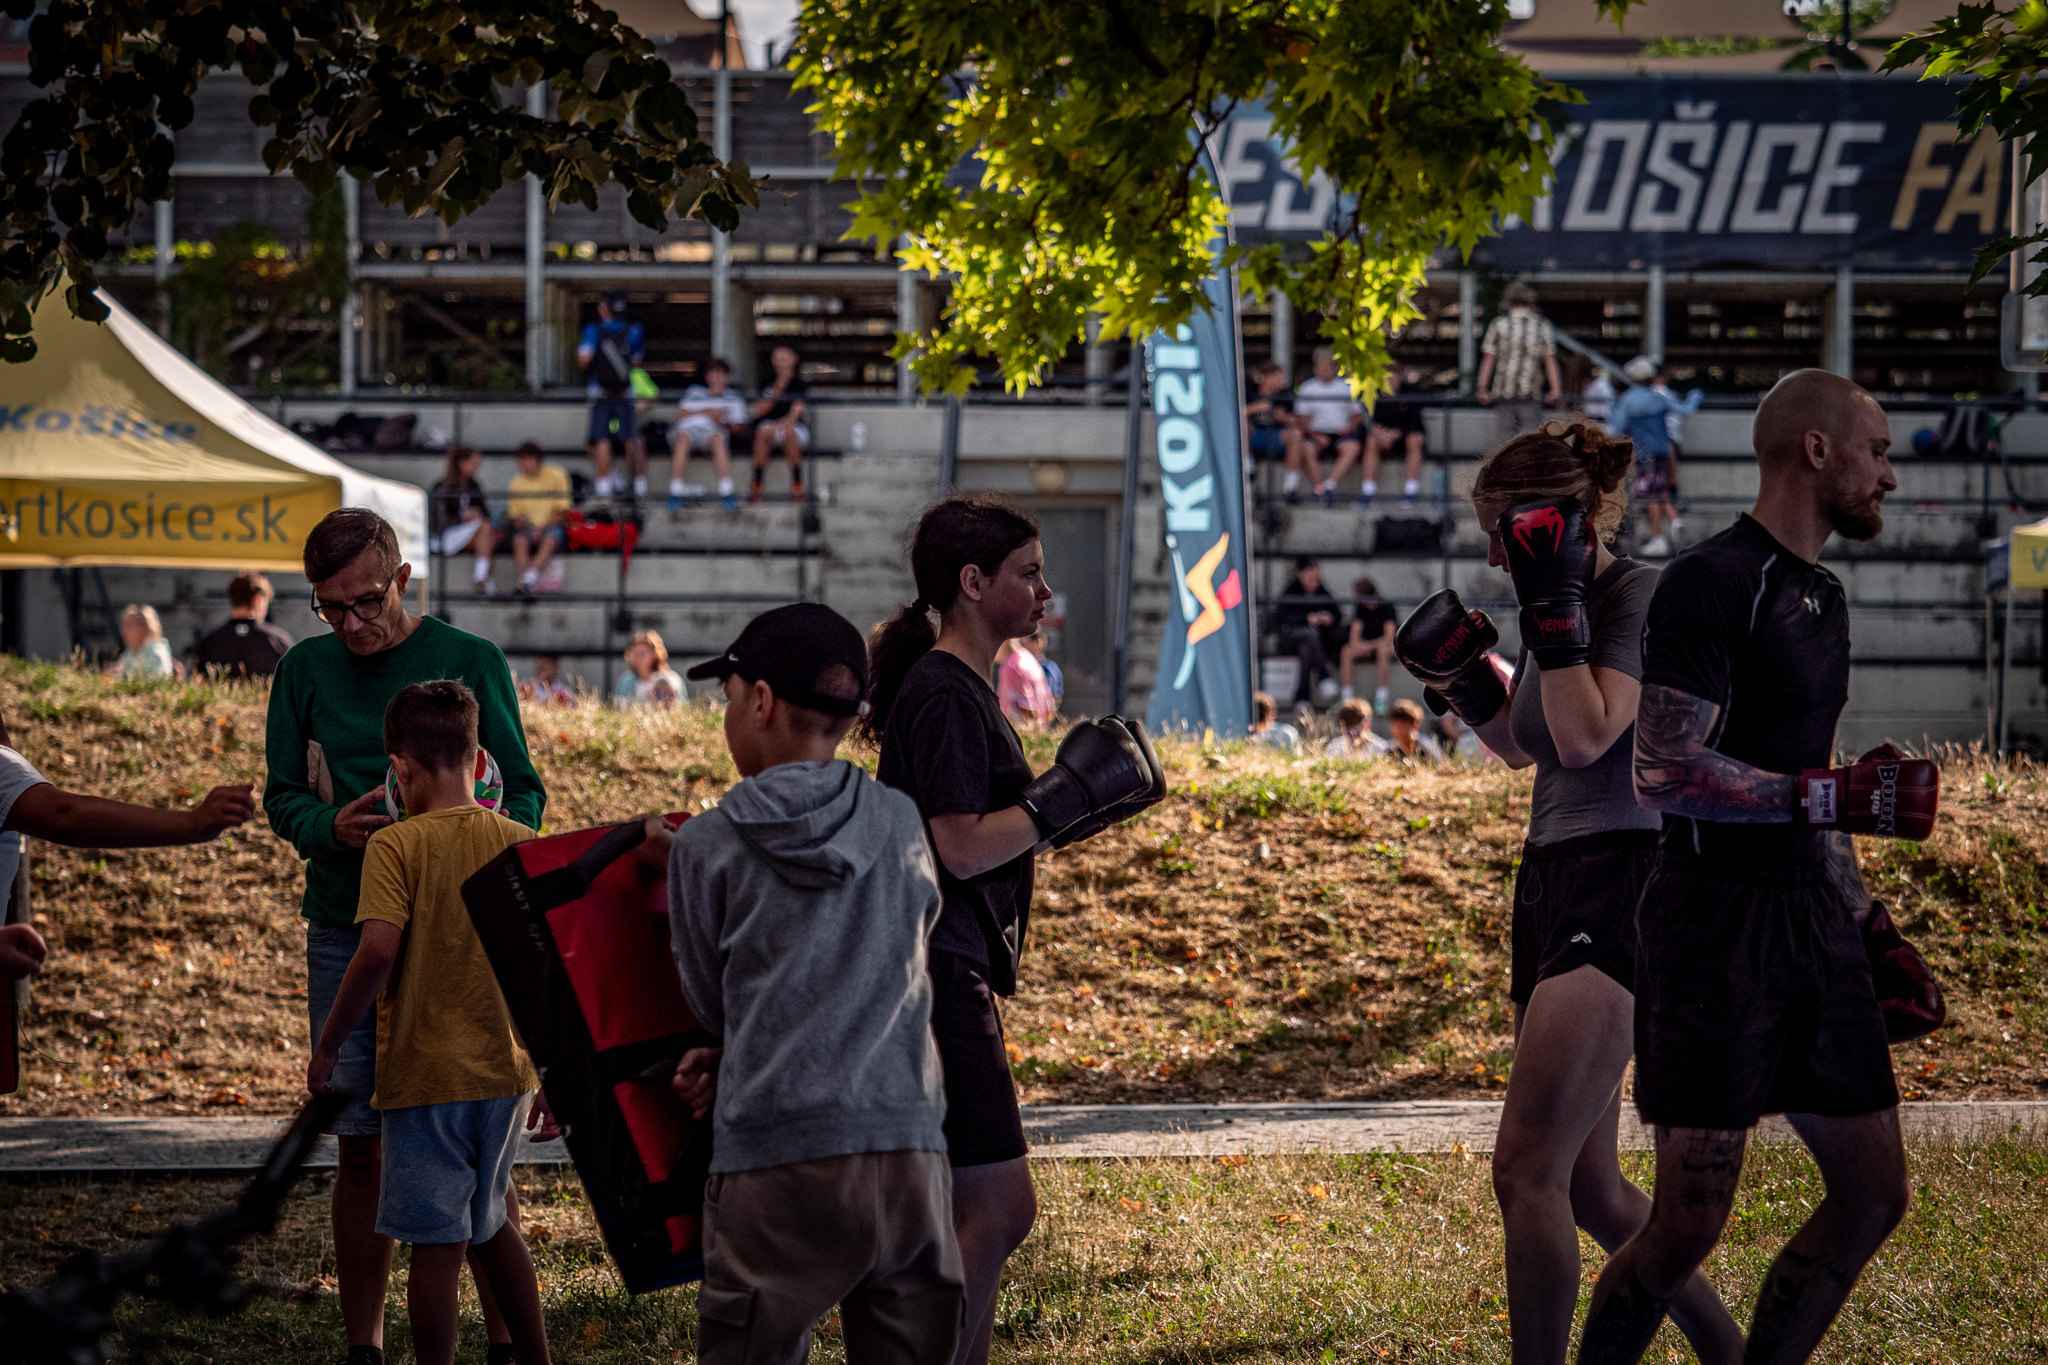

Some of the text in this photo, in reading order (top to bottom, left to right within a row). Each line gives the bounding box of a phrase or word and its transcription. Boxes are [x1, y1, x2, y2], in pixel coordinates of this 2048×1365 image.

[1890, 121, 2013, 235] FA
[0, 489, 289, 543] rtkosice.sk
[1432, 623, 1471, 666] VENUM
[1534, 613, 1578, 637] VENUM
[1821, 783, 1832, 818] BOON
[1876, 765, 1899, 837] BOON
